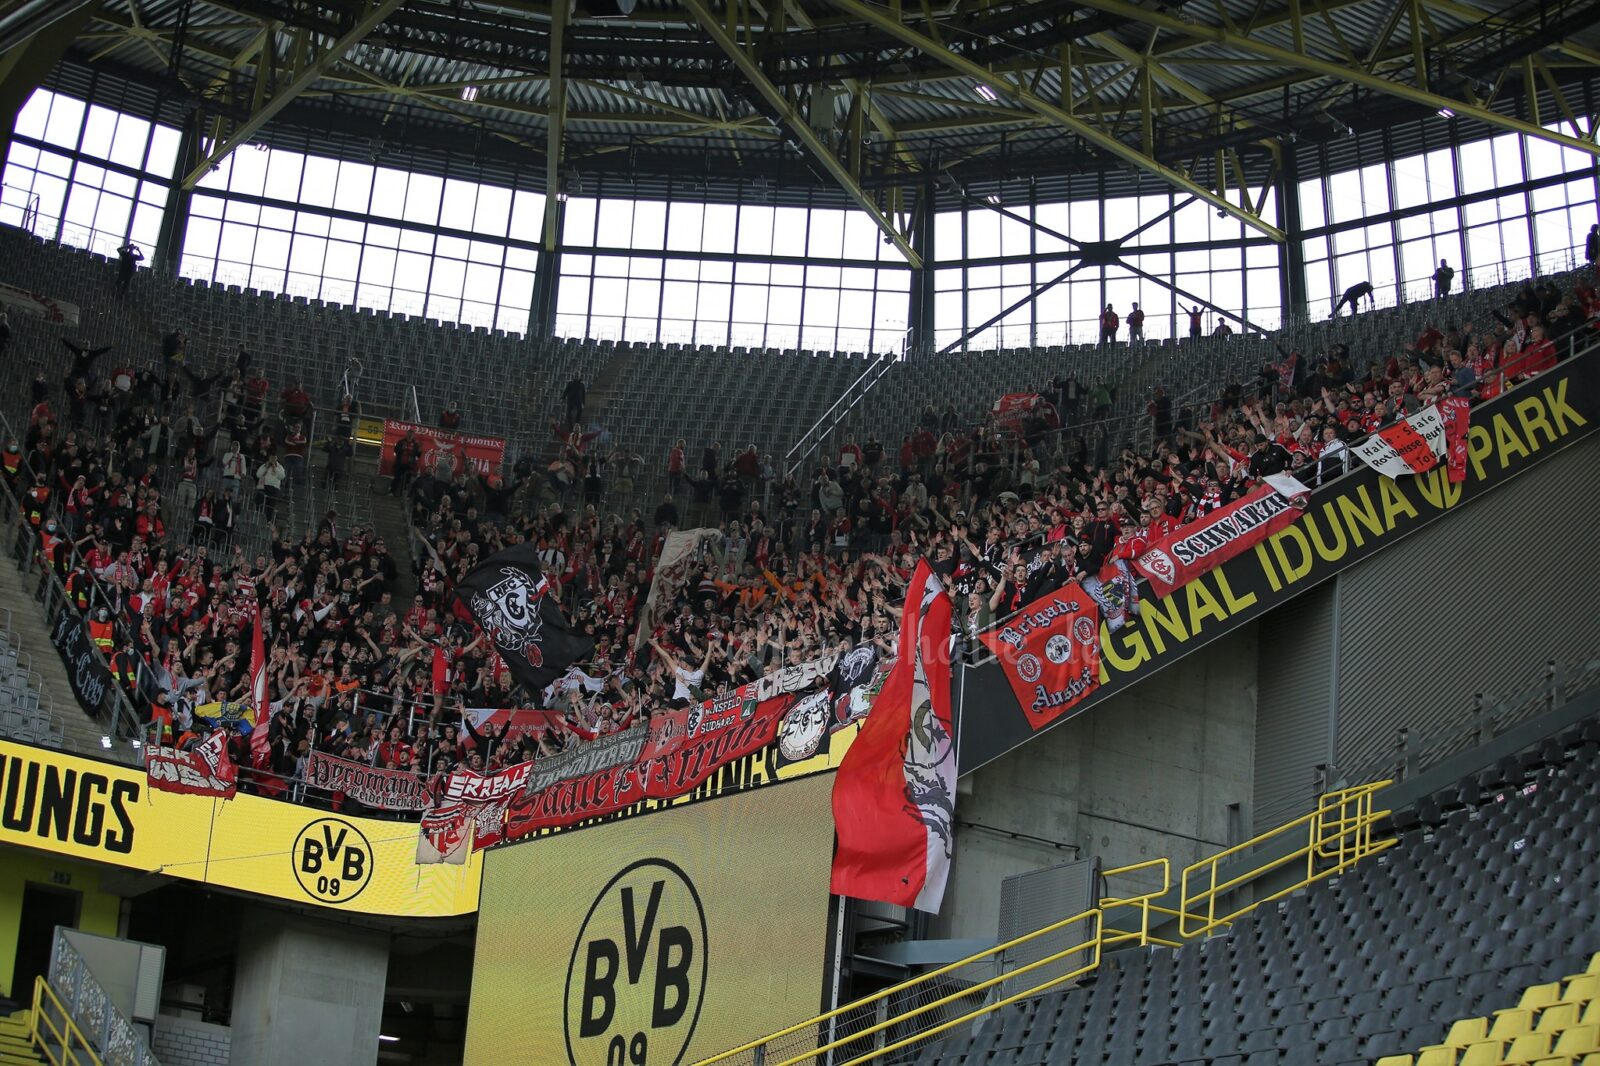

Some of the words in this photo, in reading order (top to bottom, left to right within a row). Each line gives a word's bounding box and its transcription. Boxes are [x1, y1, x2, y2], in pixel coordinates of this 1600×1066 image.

[1253, 474, 1419, 592] IDUNA
[1466, 377, 1588, 481] PARK
[1141, 551, 1161, 565] HFC
[998, 597, 1081, 651] Brigade
[0, 755, 140, 855] UNGS
[302, 825, 366, 882] BVB
[317, 875, 341, 896] 09
[579, 880, 694, 1038] BVB
[606, 1031, 648, 1066] 09
